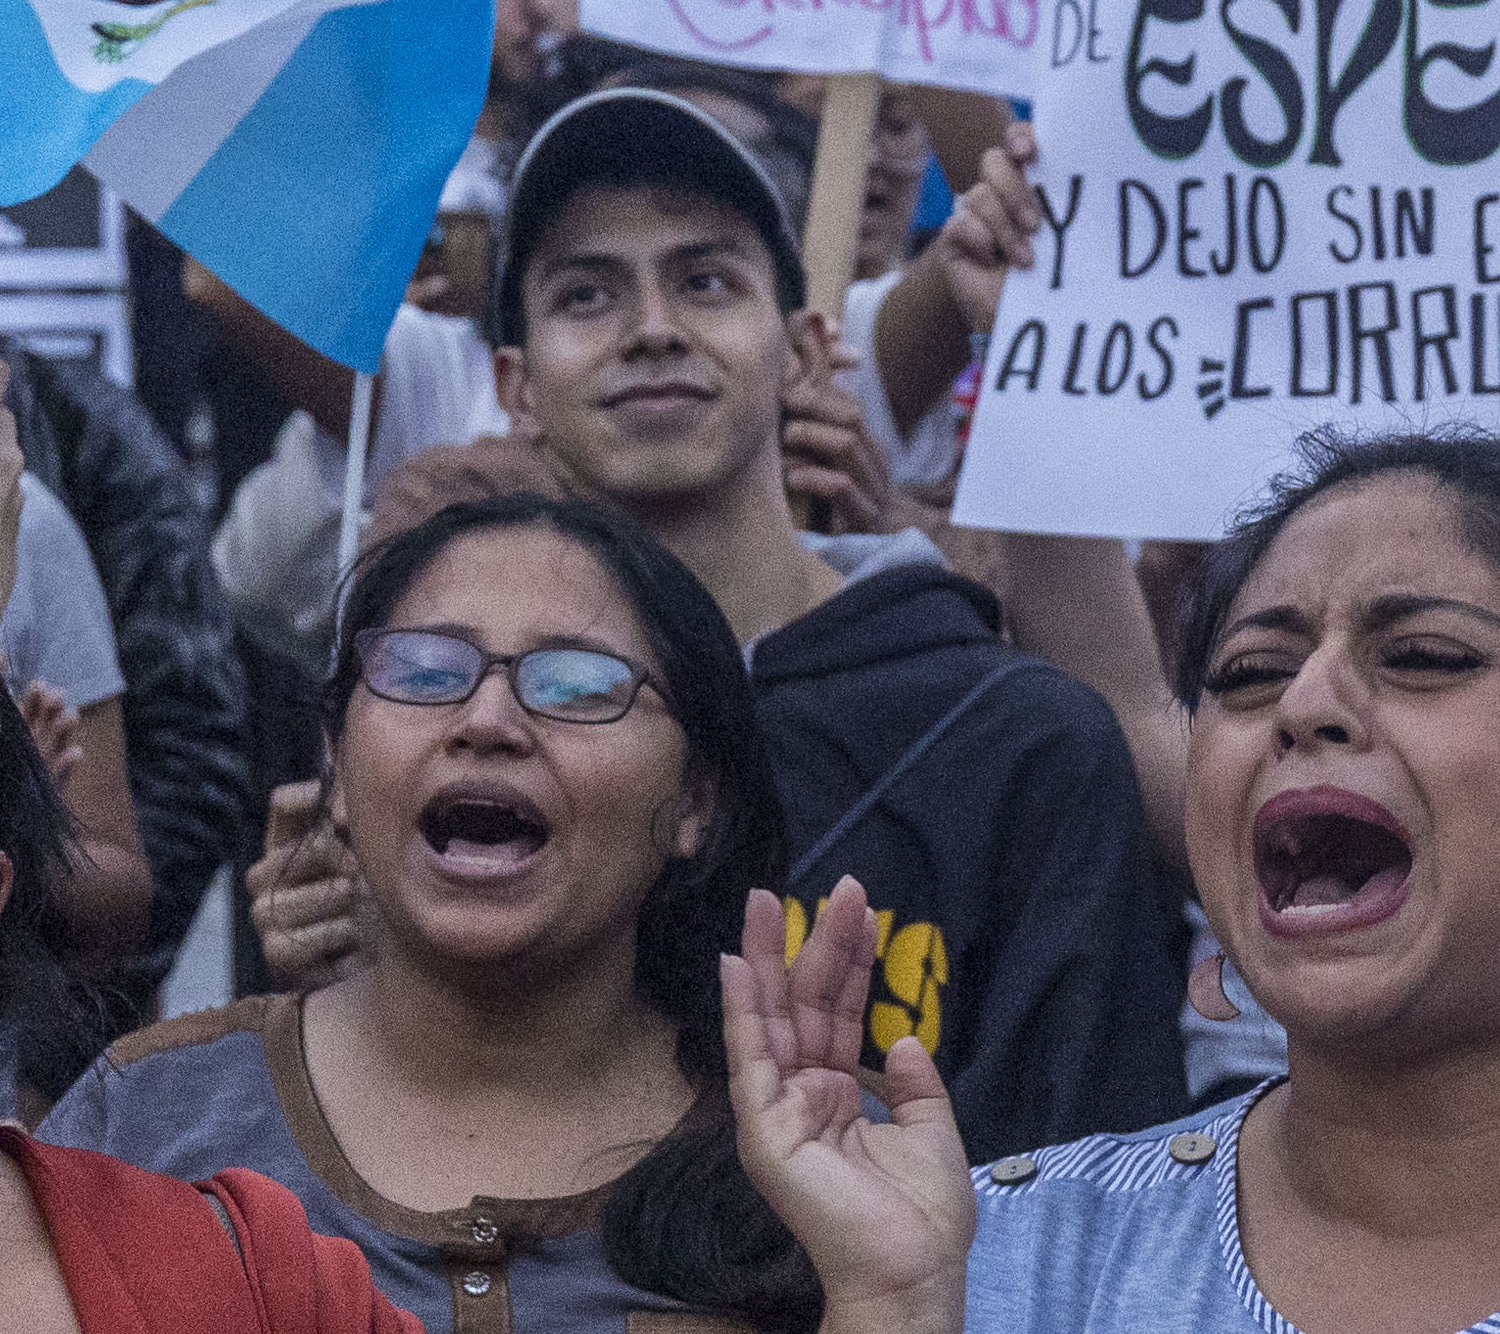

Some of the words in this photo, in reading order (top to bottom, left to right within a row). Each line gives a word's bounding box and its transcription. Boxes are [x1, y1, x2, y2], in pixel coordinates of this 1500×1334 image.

[1116, 174, 1288, 278] DEJO
[1328, 184, 1438, 266] SIN
[995, 319, 1049, 393] A
[1060, 317, 1181, 399] LOS
